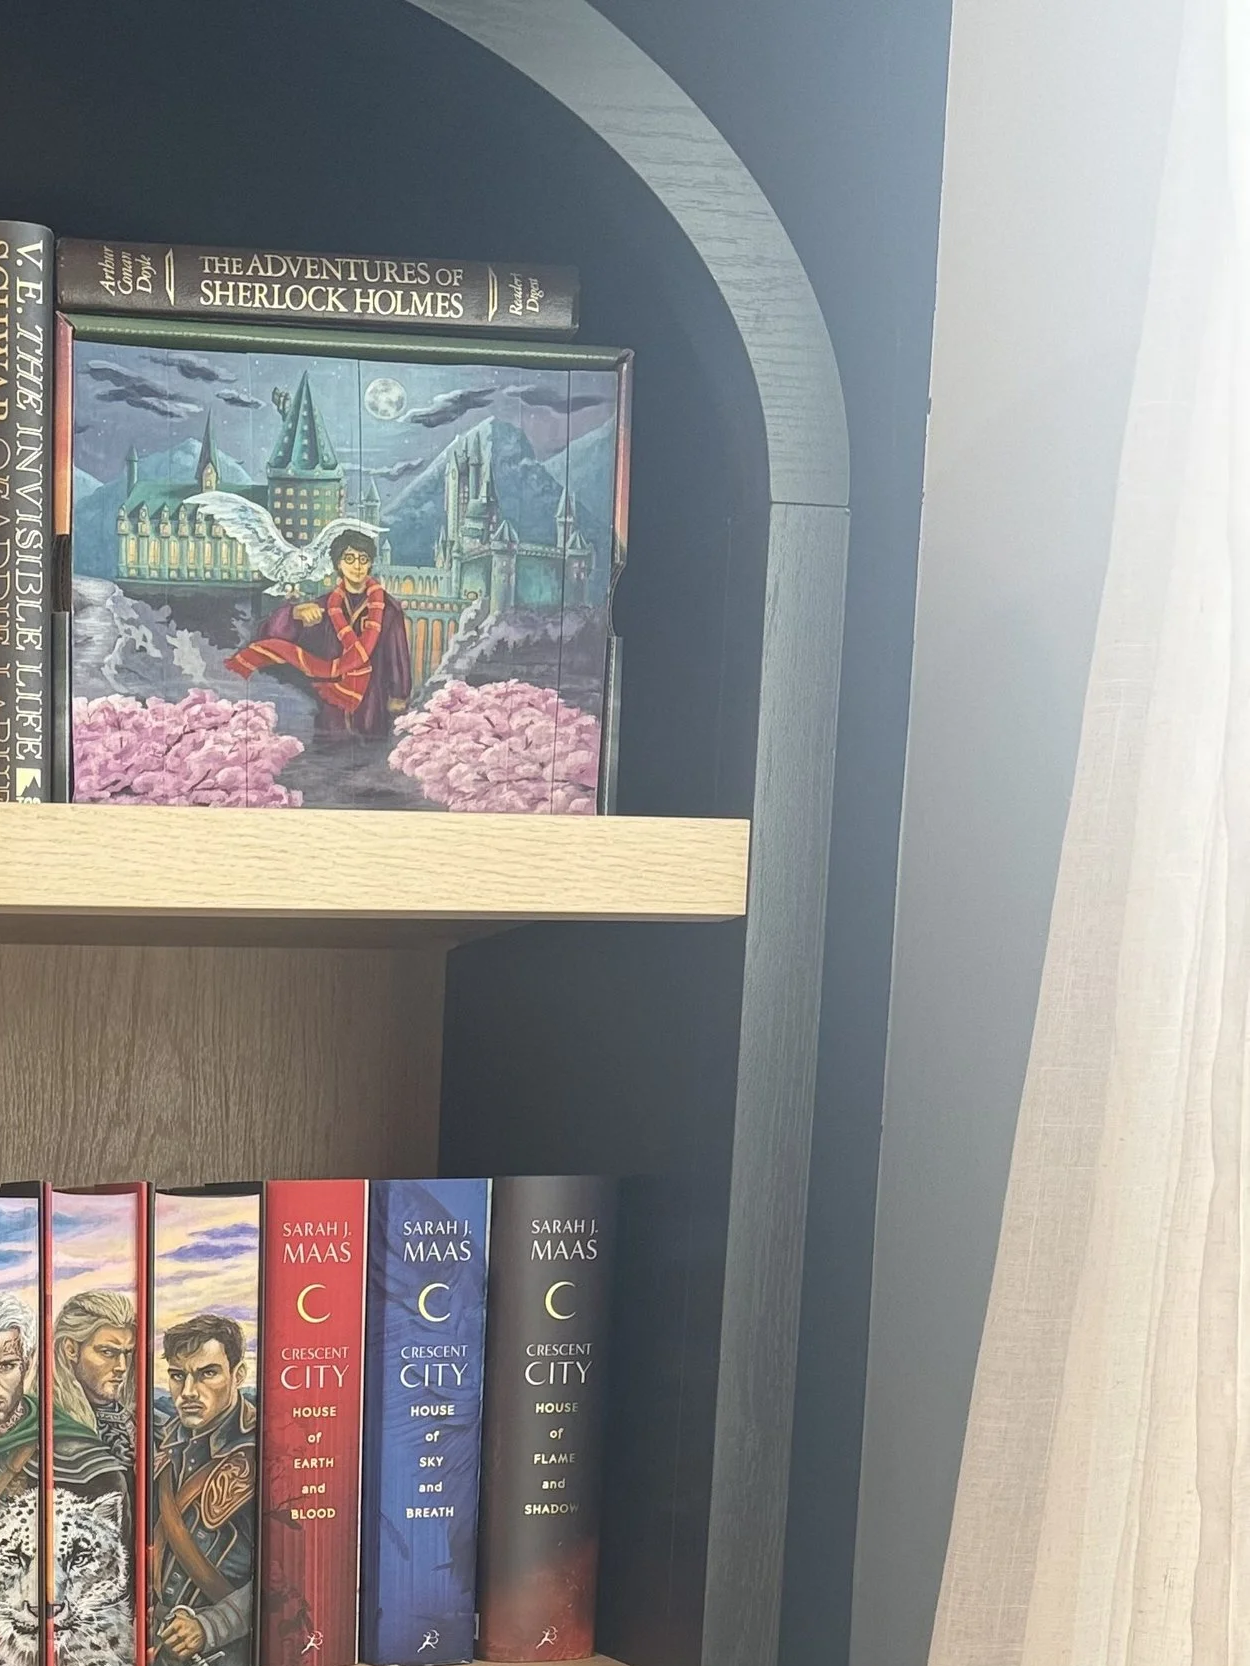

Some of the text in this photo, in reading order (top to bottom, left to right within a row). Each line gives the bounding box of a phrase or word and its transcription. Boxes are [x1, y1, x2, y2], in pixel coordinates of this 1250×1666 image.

[16, 239, 44, 314] V. E.
[98, 246, 115, 296] Arthur
[117, 251, 133, 295] Conan
[136, 254, 157, 293] Doyle
[199, 254, 463, 287] THE ADVENTURES OF
[200, 280, 463, 319] SHERLOCK HOLMES
[526, 277, 545, 313] Digest
[15, 324, 44, 761] THE INVISIBLE LIFE
[283, 1221, 352, 1237] SARAH J.
[403, 1220, 472, 1236] SARAH J.
[531, 1219, 599, 1235] SARAH J.
[282, 1242, 352, 1264] MAAS
[403, 1241, 472, 1262] MAAS
[530, 1240, 598, 1261] MAAS
[281, 1346, 349, 1361] CRESCENT
[401, 1345, 468, 1359] CRESCENT
[526, 1343, 593, 1357] CRESCENT
[280, 1364, 350, 1389] CITY
[400, 1363, 469, 1388] CITY
[524, 1361, 593, 1386] CITY
[292, 1406, 337, 1418] HOUSE
[410, 1404, 455, 1417] HOUSE
[535, 1402, 579, 1414] HOUSE
[307, 1431, 322, 1444] of
[425, 1430, 440, 1443] of
[549, 1427, 564, 1440] of
[293, 1457, 334, 1470] EARTH
[419, 1456, 444, 1468] SKY
[533, 1453, 576, 1465] FLAME
[301, 1482, 326, 1495] and
[418, 1481, 443, 1493] and
[542, 1478, 566, 1490] and
[290, 1507, 336, 1520] BLOOD
[406, 1506, 454, 1519] BREATH
[524, 1503, 580, 1515] SHADOW
